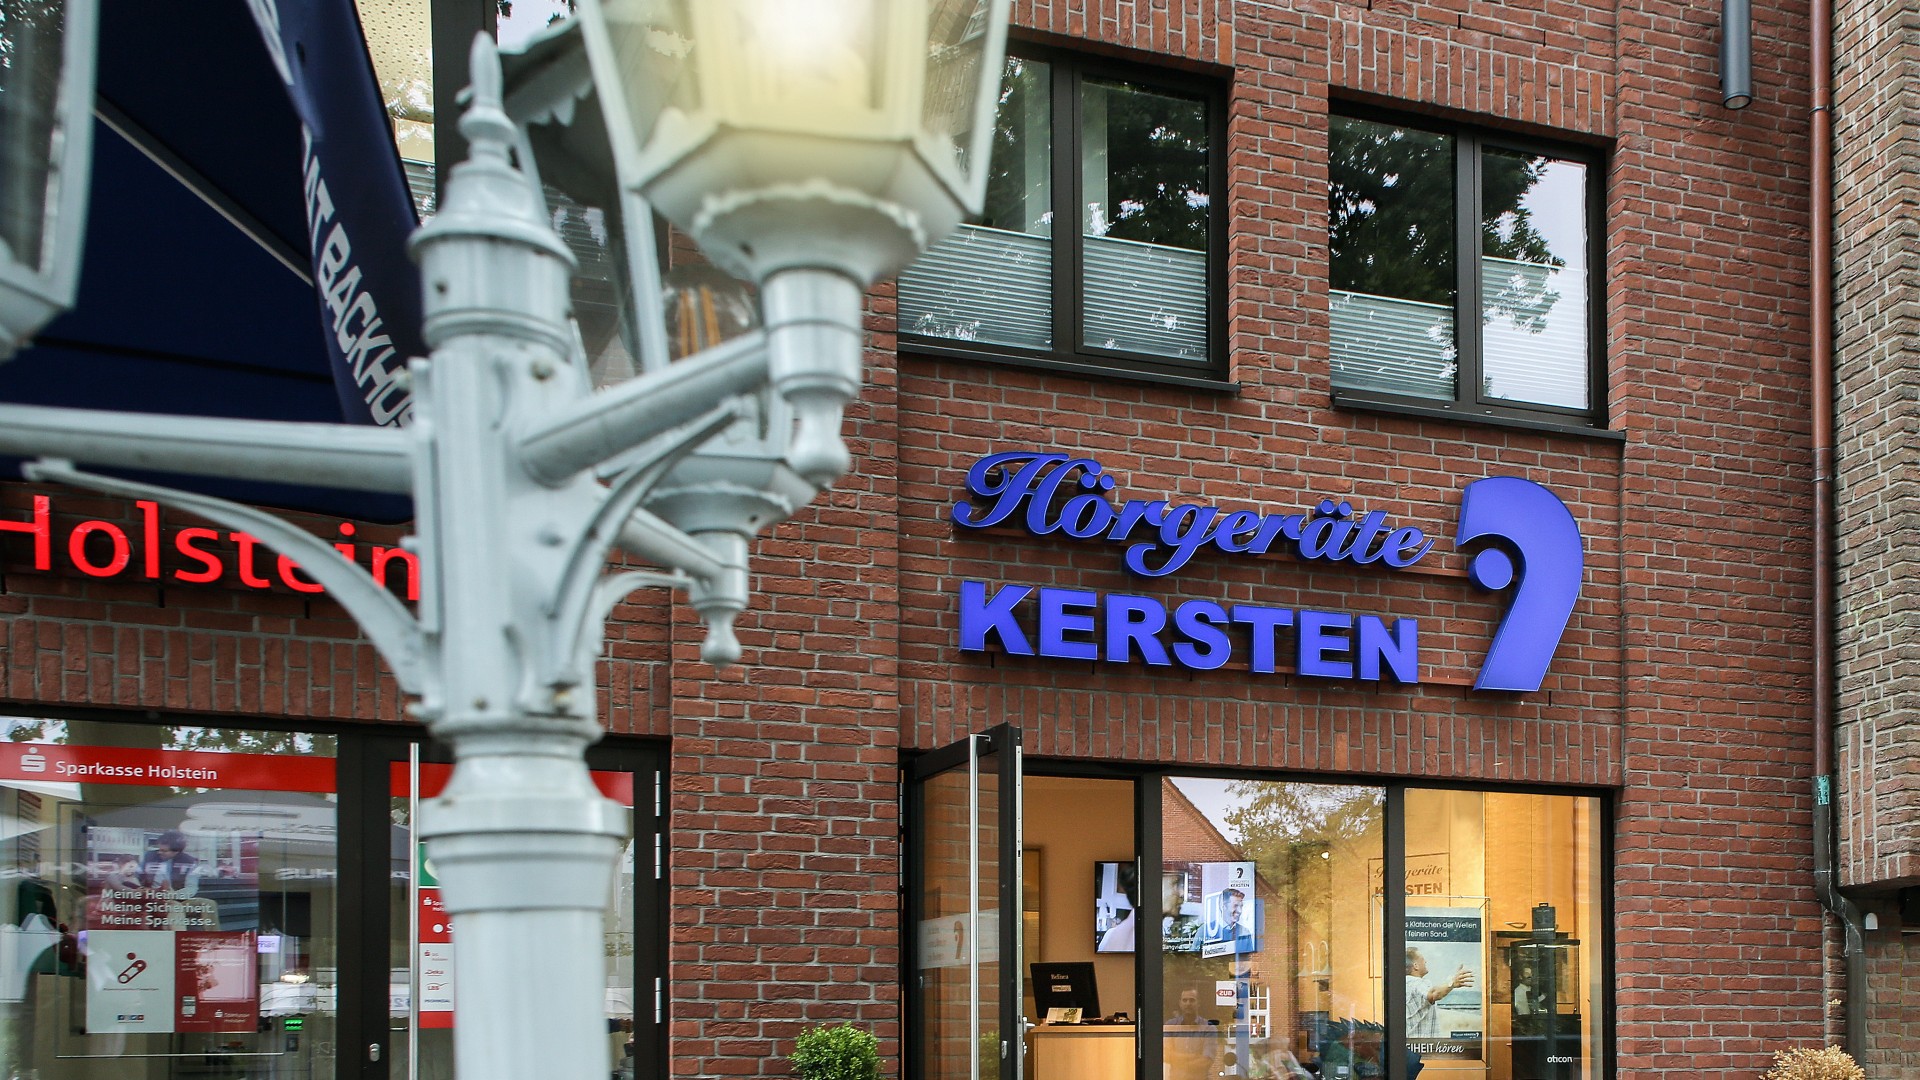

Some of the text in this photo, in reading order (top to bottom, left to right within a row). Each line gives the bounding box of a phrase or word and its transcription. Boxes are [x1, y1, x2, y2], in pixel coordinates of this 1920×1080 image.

[952, 451, 1434, 578] Hörgeräte
[958, 579, 1419, 685] KERSTEN
[55, 760, 218, 781] Sparkasse Holstein
[101, 888, 142, 900] Meine
[1375, 882, 1443, 896] KSTEN
[101, 901, 215, 914] Meine Sicherheit.
[101, 914, 216, 928] Meine Sparkasse.
[1405, 1041, 1464, 1054] EIHEIT hören
[1546, 1054, 1573, 1063] oticon
